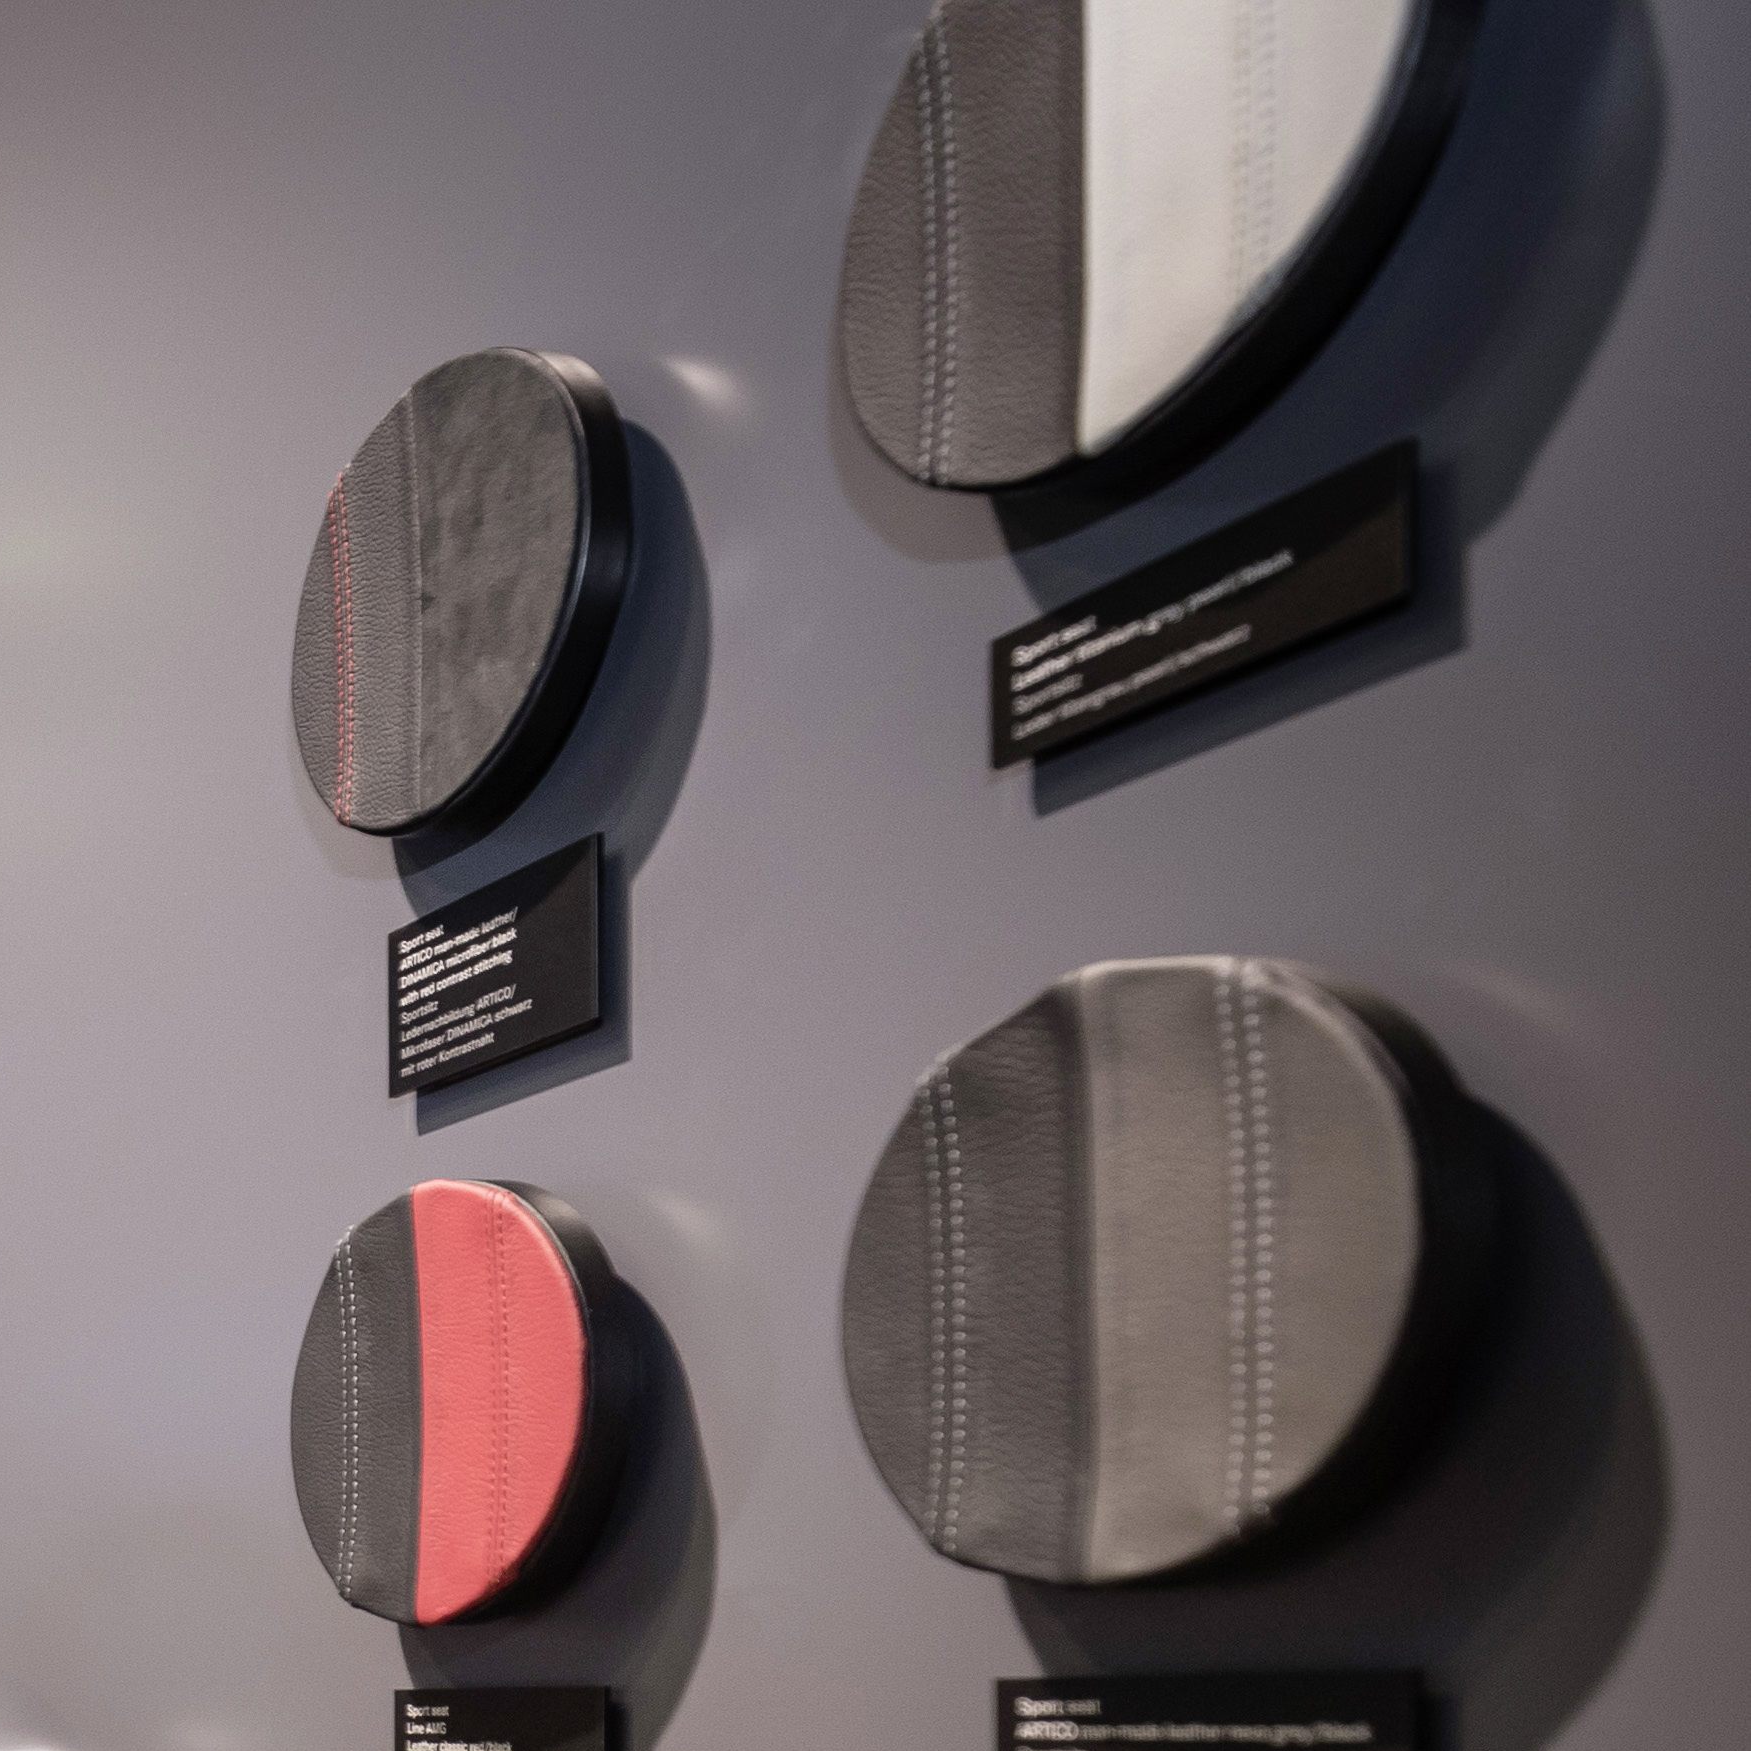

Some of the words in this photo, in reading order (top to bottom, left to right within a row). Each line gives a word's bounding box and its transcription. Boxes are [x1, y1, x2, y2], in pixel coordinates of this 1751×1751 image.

[400, 932, 424, 954] Sport
[400, 946, 433, 970] ARTICO
[400, 964, 445, 989] DINAMICA
[400, 989, 419, 1006] with
[436, 967, 473, 991] contrast
[476, 984, 517, 1010] ARTICO/
[401, 1001, 438, 1025] Sportsitz
[447, 1014, 493, 1041] DINAMICA
[495, 999, 533, 1021] schwarz
[405, 1704, 429, 1718] Sport
[406, 1721, 424, 1734] Line
[425, 1721, 447, 1734] AMG
[1014, 1721, 1079, 1741] ARTICO
